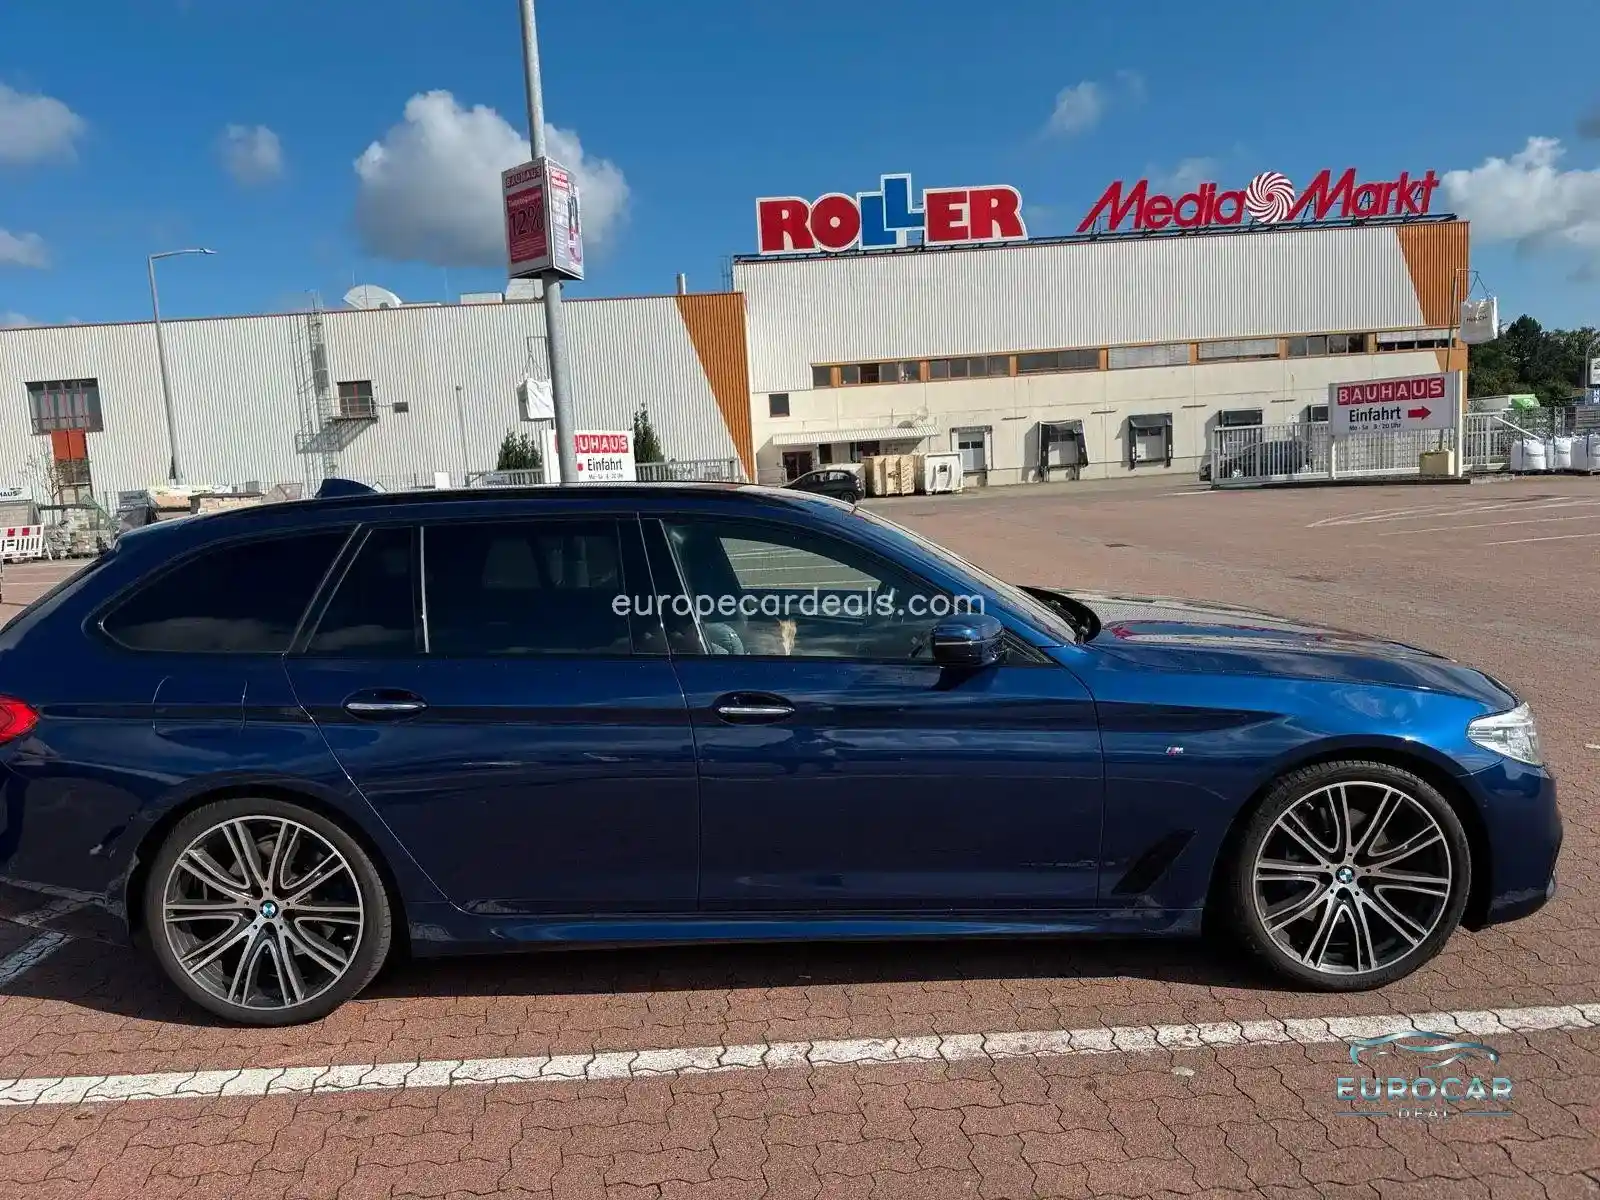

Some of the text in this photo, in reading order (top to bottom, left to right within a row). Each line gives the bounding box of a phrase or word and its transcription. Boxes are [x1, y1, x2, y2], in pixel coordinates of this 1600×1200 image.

[506, 167, 541, 188] BAUHAUS
[1076, 168, 1440, 233] Media Markt
[757, 173, 1028, 254] ROLLER
[1338, 378, 1443, 404] BAUHAUS
[1349, 406, 1402, 422] Einfahrt
[575, 434, 628, 453] UHAUS
[587, 458, 623, 471] Einfahrt
